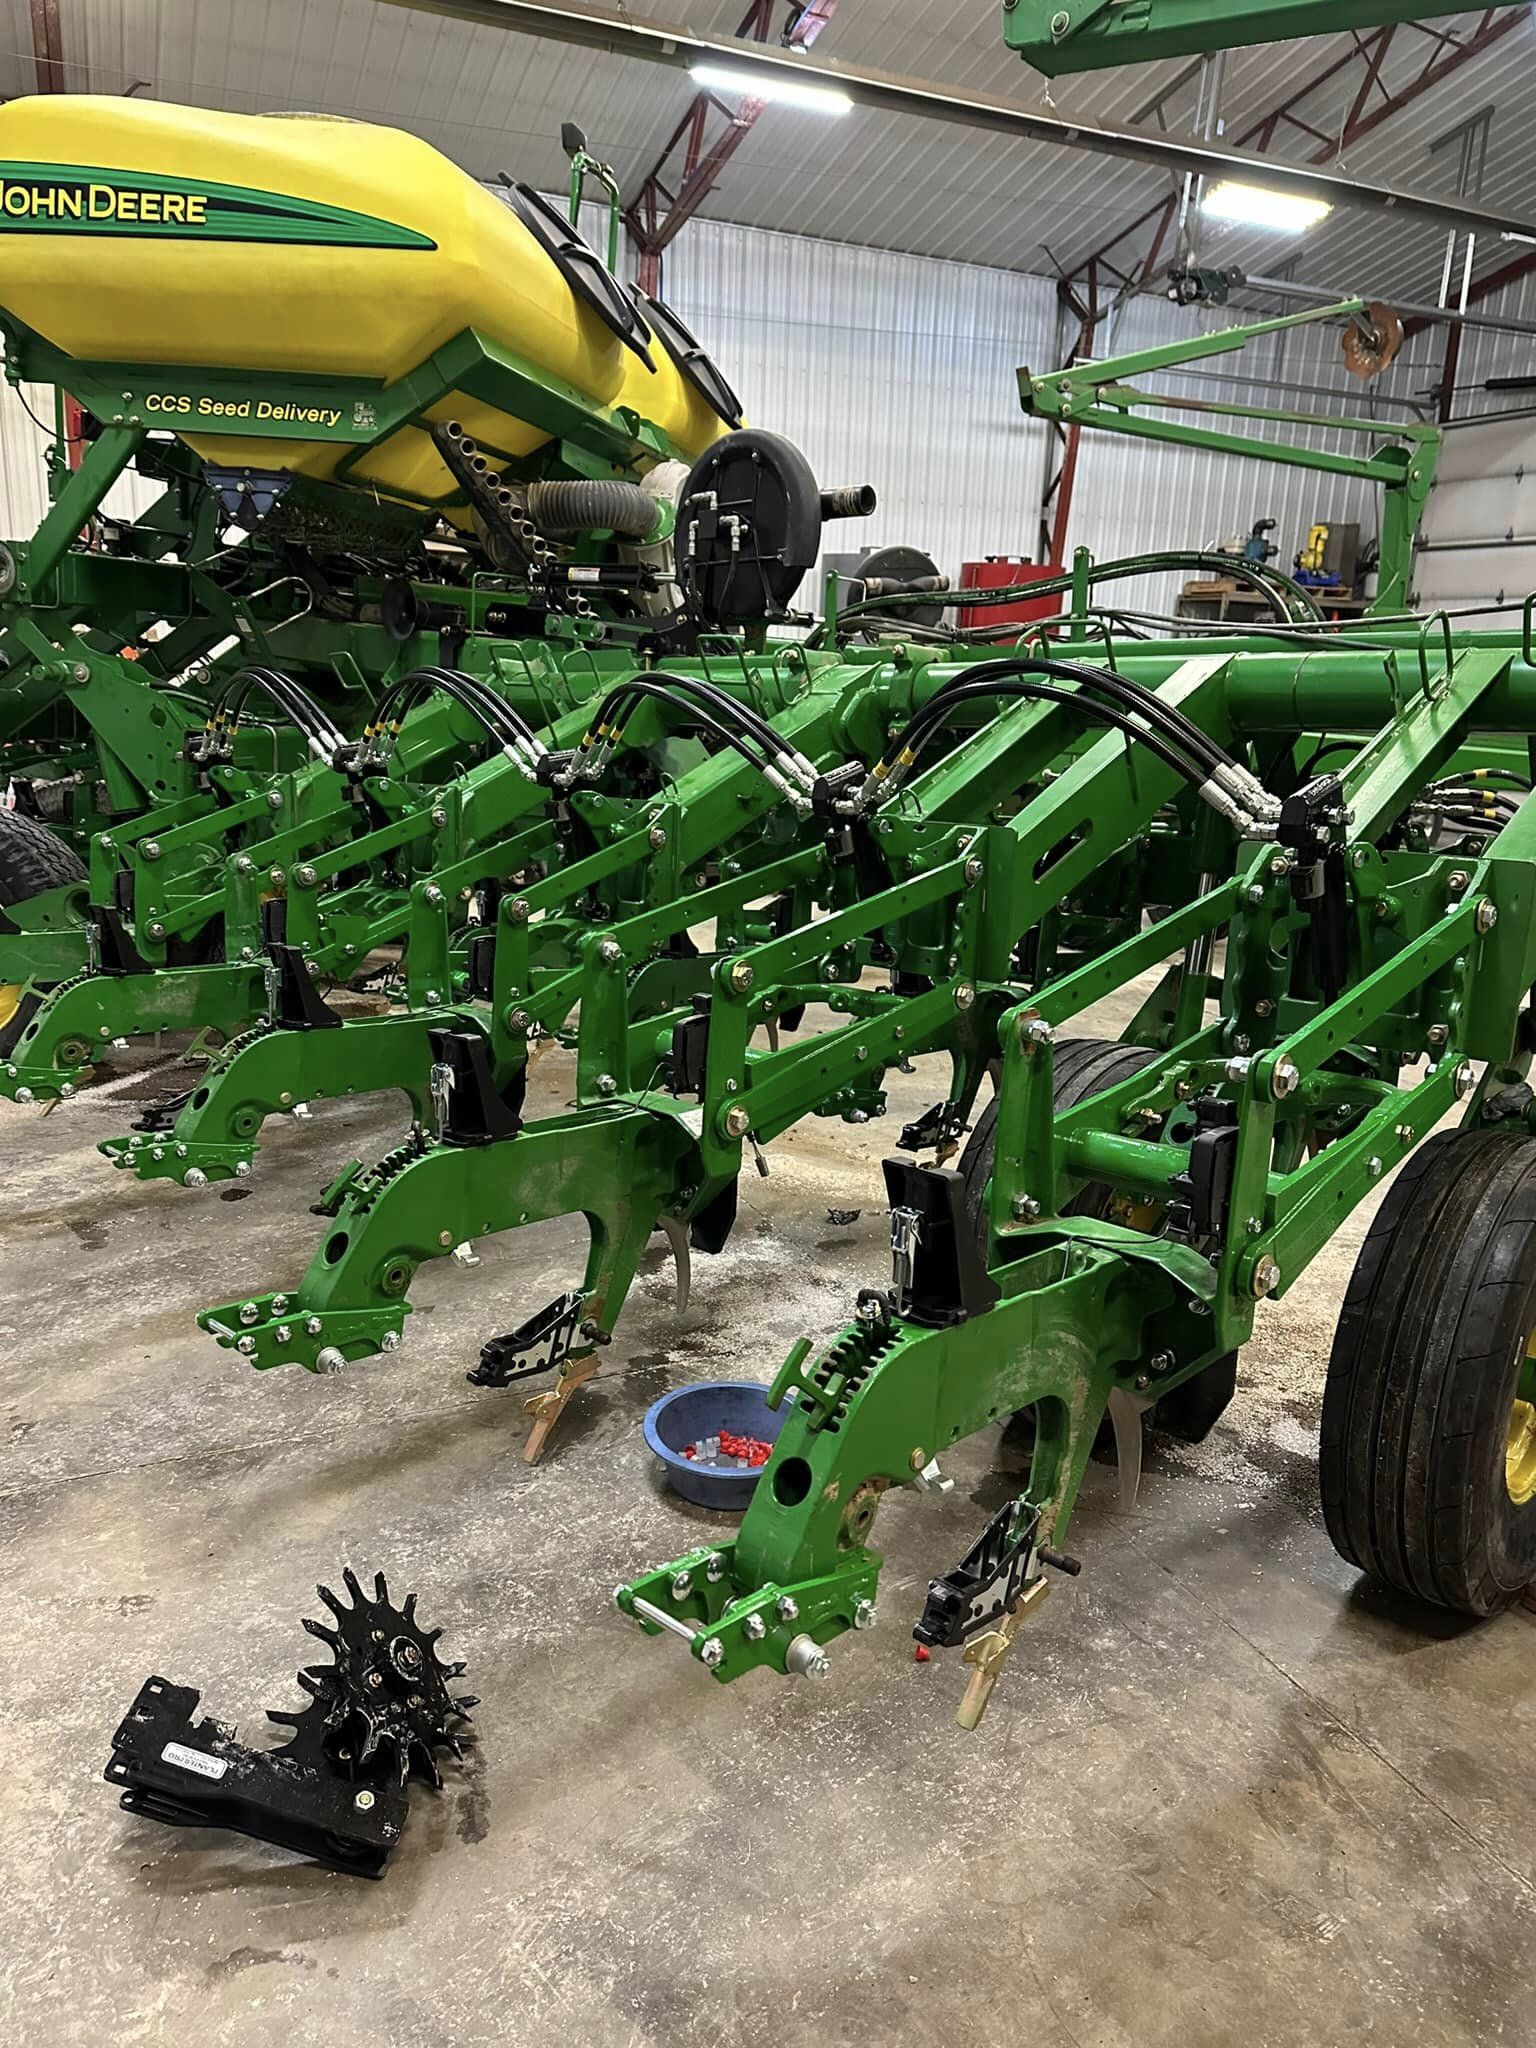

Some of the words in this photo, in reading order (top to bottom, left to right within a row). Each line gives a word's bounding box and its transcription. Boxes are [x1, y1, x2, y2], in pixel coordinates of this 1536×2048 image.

[89, 184, 208, 223] DEERE
[145, 394, 191, 413] CCS
[197, 397, 250, 418] Seed
[256, 401, 341, 427] Delivery
